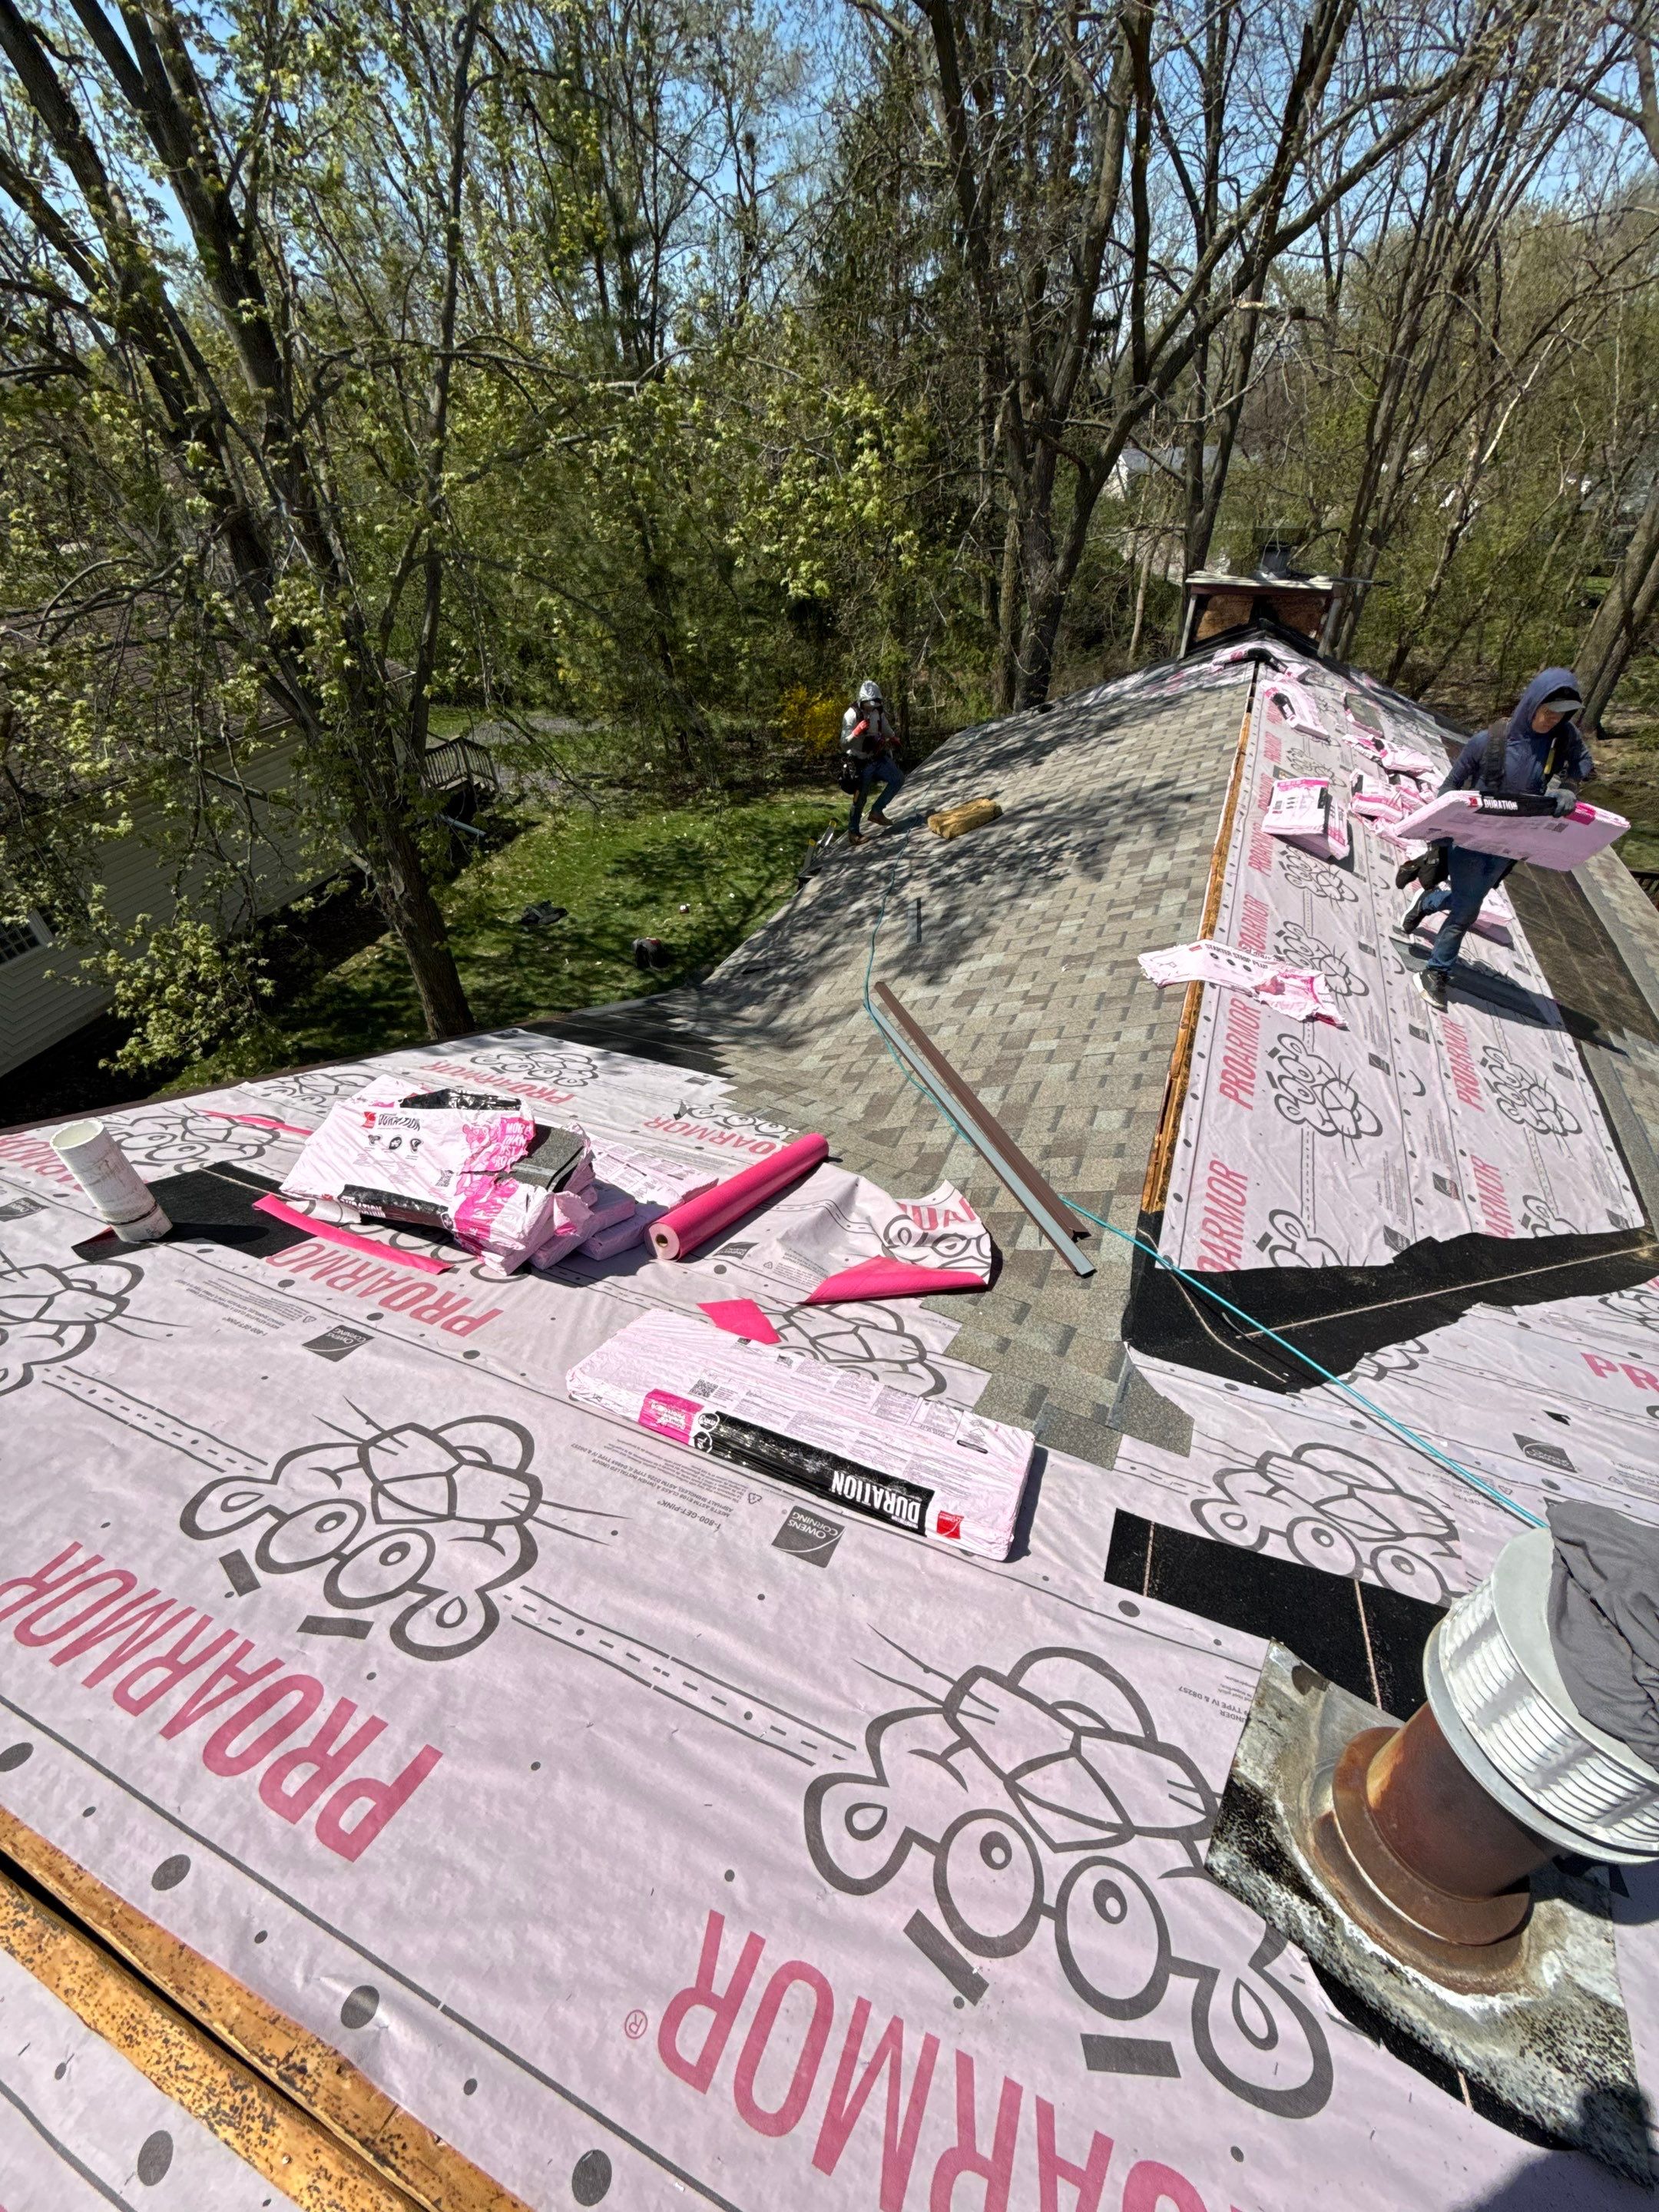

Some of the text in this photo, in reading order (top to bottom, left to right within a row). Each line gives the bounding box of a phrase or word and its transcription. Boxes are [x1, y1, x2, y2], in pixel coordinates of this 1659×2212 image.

[1483, 796, 1518, 812] DURATION
[1218, 995, 1260, 1110] PROARMOR
[1443, 1018, 1483, 1111] PROARMOR
[591, 1457, 610, 1469] UNDER
[598, 1453, 611, 1462] TYPE
[609, 1465, 638, 1480] INSTALLED
[632, 1468, 647, 1477] TYPE
[661, 1485, 679, 1496] CLASS
[831, 1472, 921, 1524] DURATION
[707, 1498, 733, 1513] ASPHALT
[710, 1506, 730, 1518] MEETS
[786, 1518, 827, 1540] OWENS
[790, 1511, 839, 1537] CORNING
[1177, 1685, 1203, 1699] D8257
[0, 1541, 444, 1862] PROARMOR
[1210, 1698, 1220, 1707] IV
[1220, 1702, 1243, 1714] TYPE
